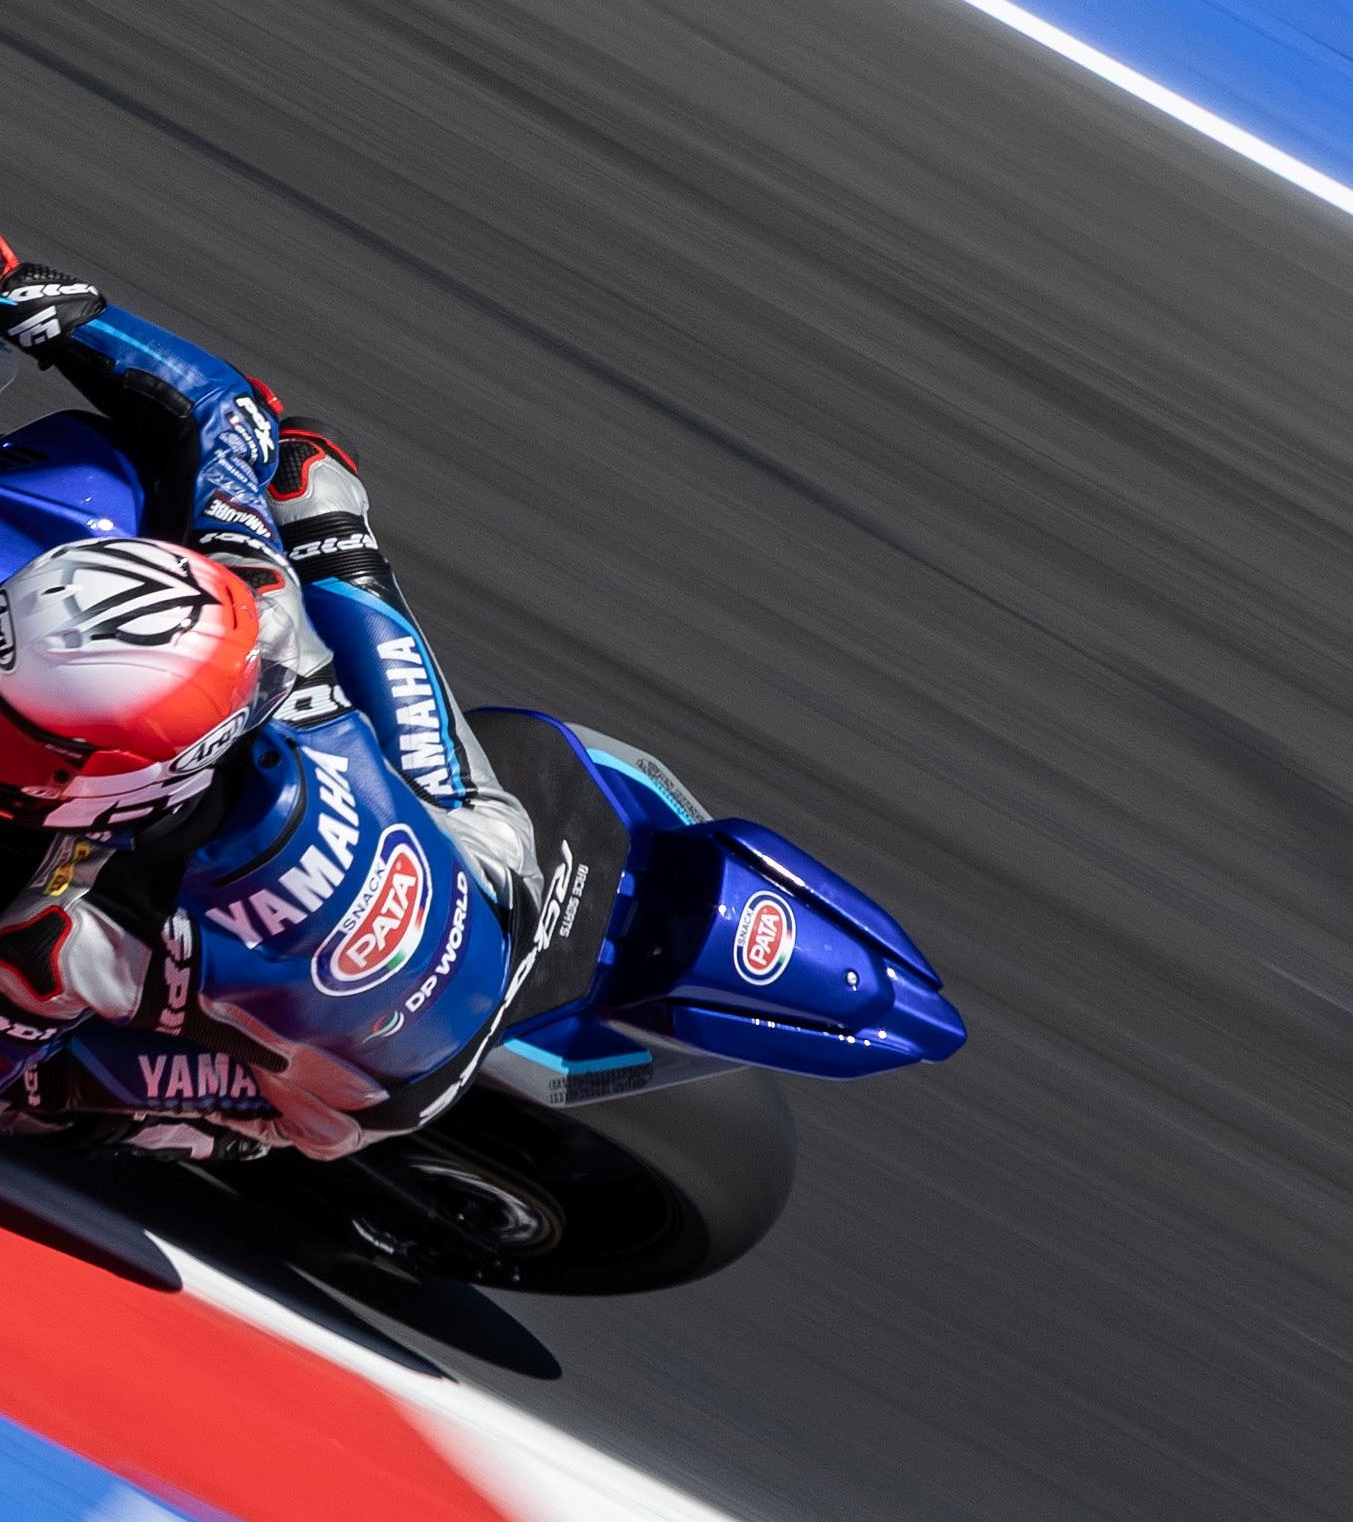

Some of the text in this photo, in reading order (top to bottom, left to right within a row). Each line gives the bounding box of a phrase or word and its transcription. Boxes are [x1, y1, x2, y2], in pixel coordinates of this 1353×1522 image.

[377, 635, 453, 797] AMAHA
[205, 745, 360, 950] YAMAHA
[343, 861, 386, 932] SNACK
[347, 868, 417, 967] PATA
[558, 863, 589, 938] RACE SEATS
[737, 907, 754, 950] SNACK
[404, 871, 469, 1013] DP WORLD
[749, 911, 781, 967] PATA
[138, 1052, 258, 1099] YAMA
